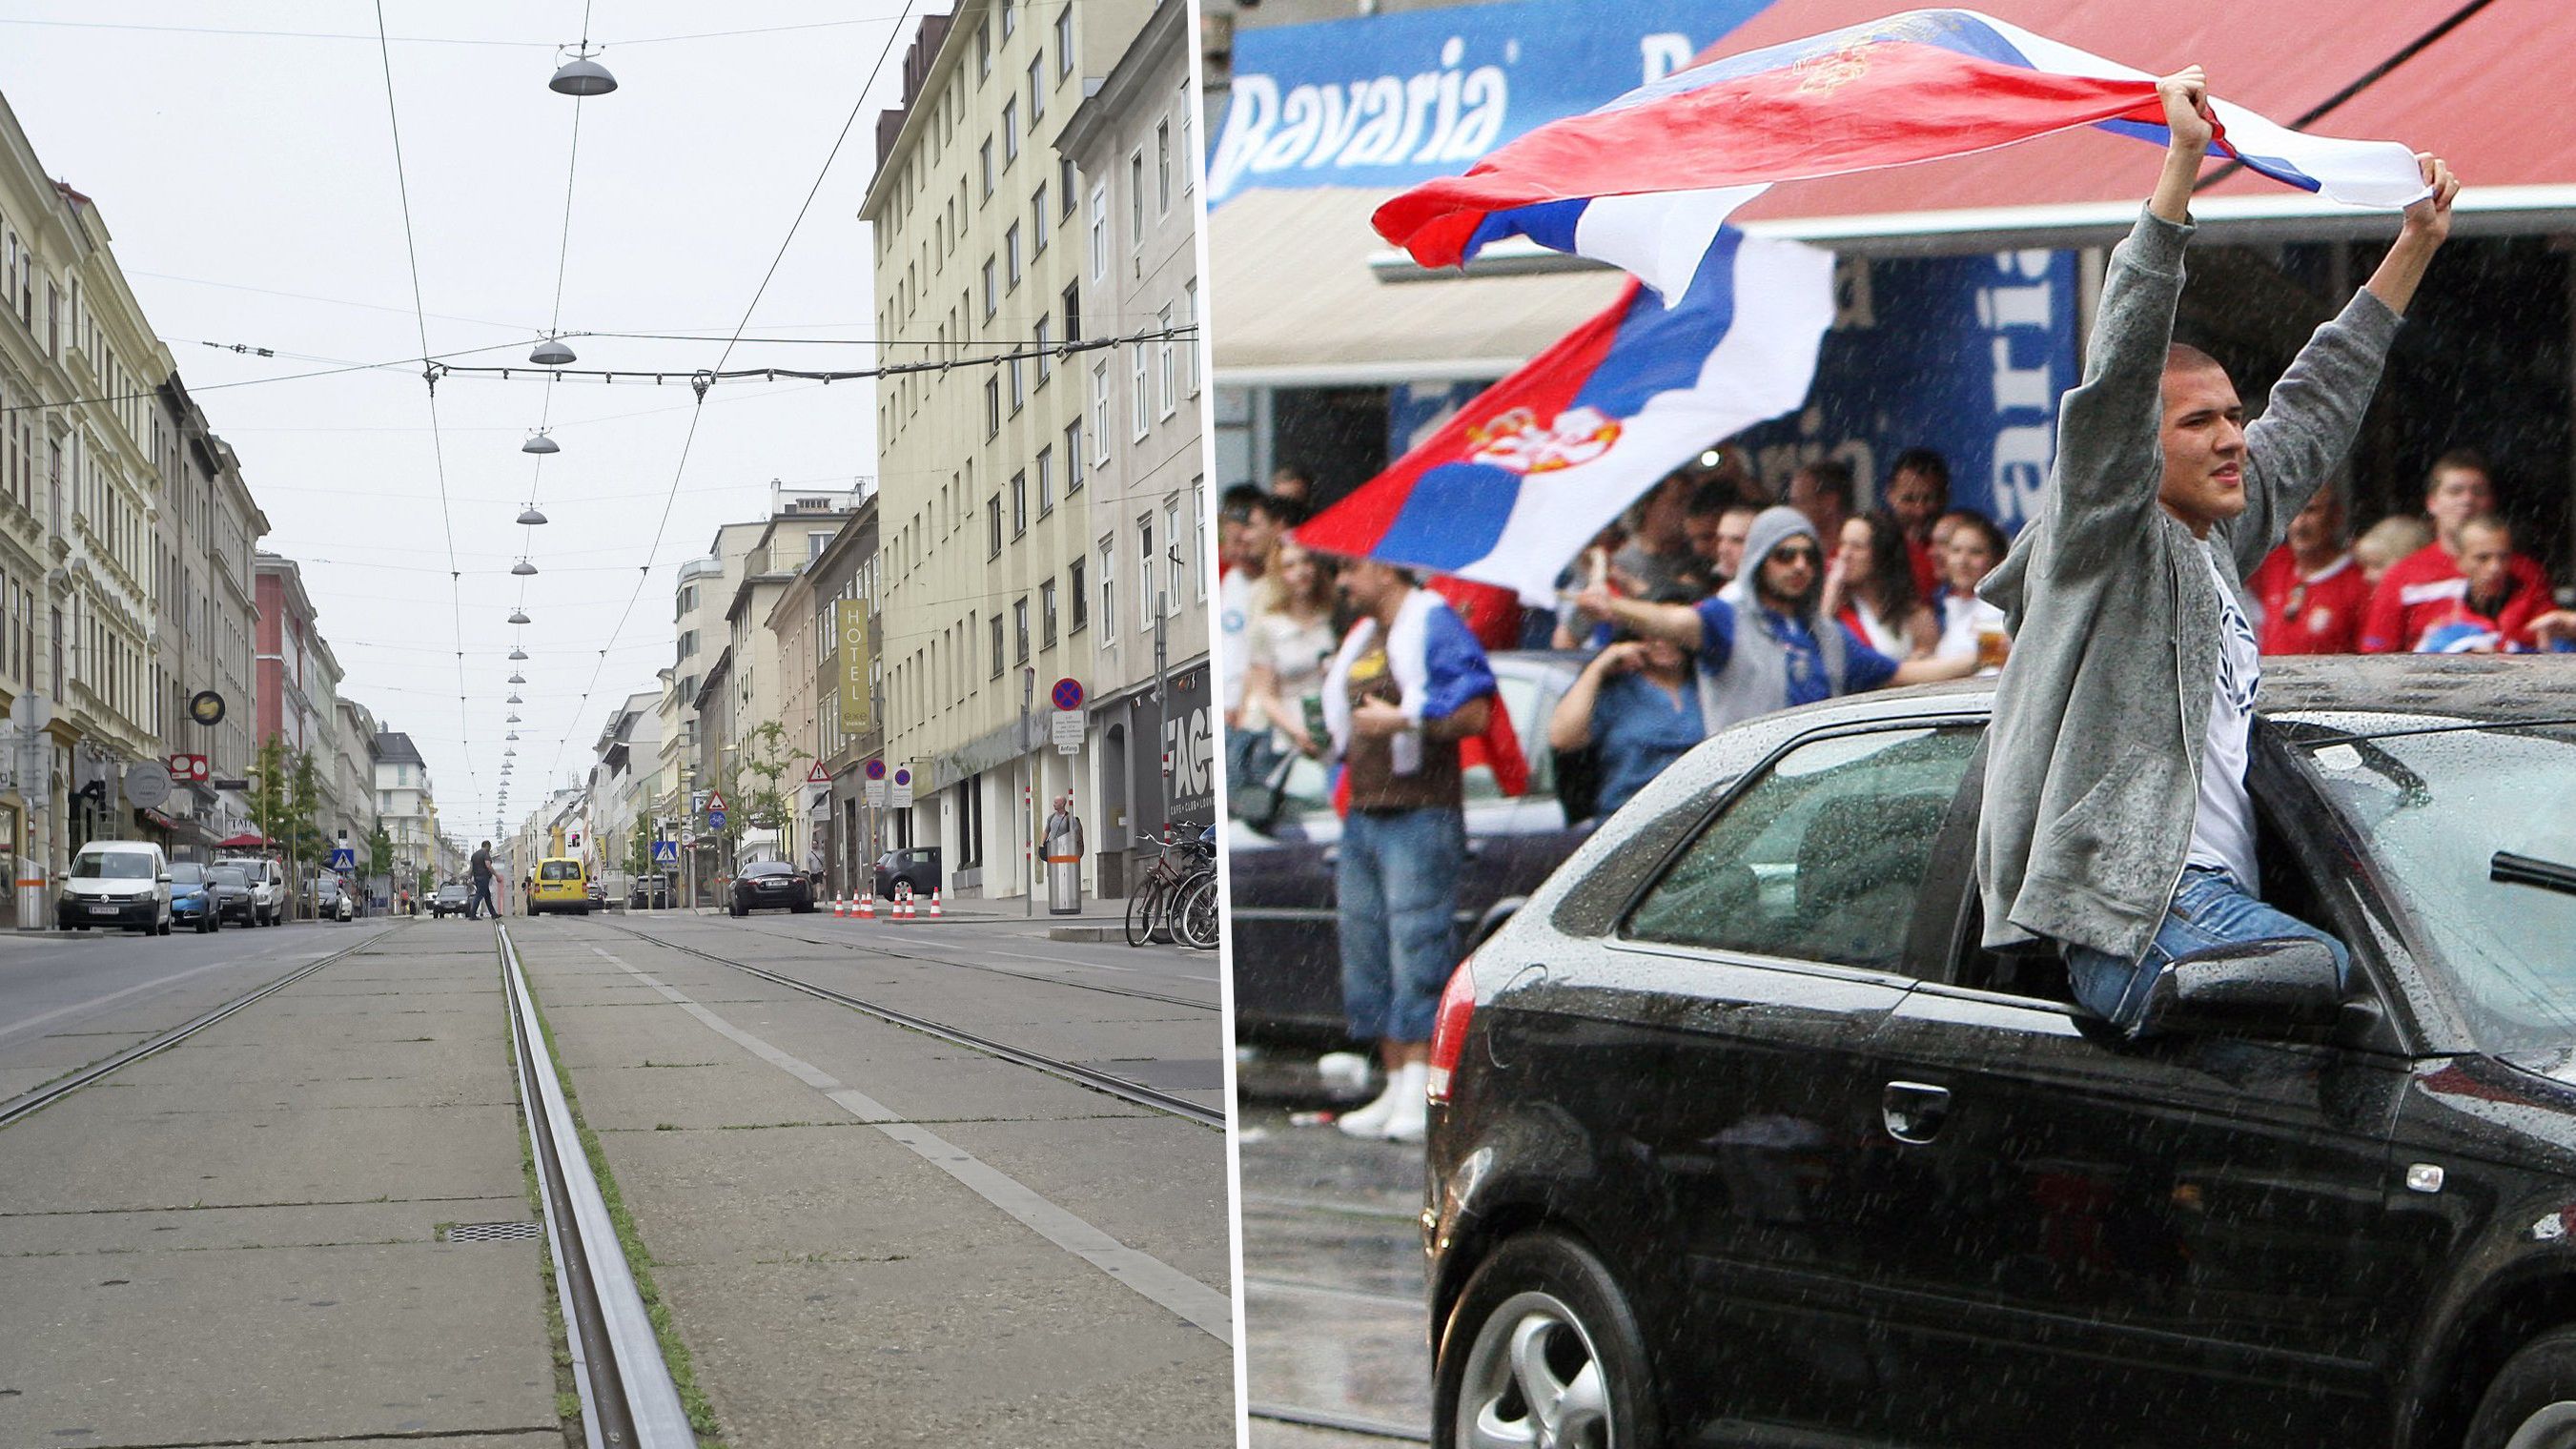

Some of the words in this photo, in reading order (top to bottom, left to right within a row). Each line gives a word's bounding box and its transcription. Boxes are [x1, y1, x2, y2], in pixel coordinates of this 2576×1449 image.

[1207, 37, 1507, 201] Bavaria
[847, 610, 861, 700] HOTEL
[845, 712, 868, 721] exe
